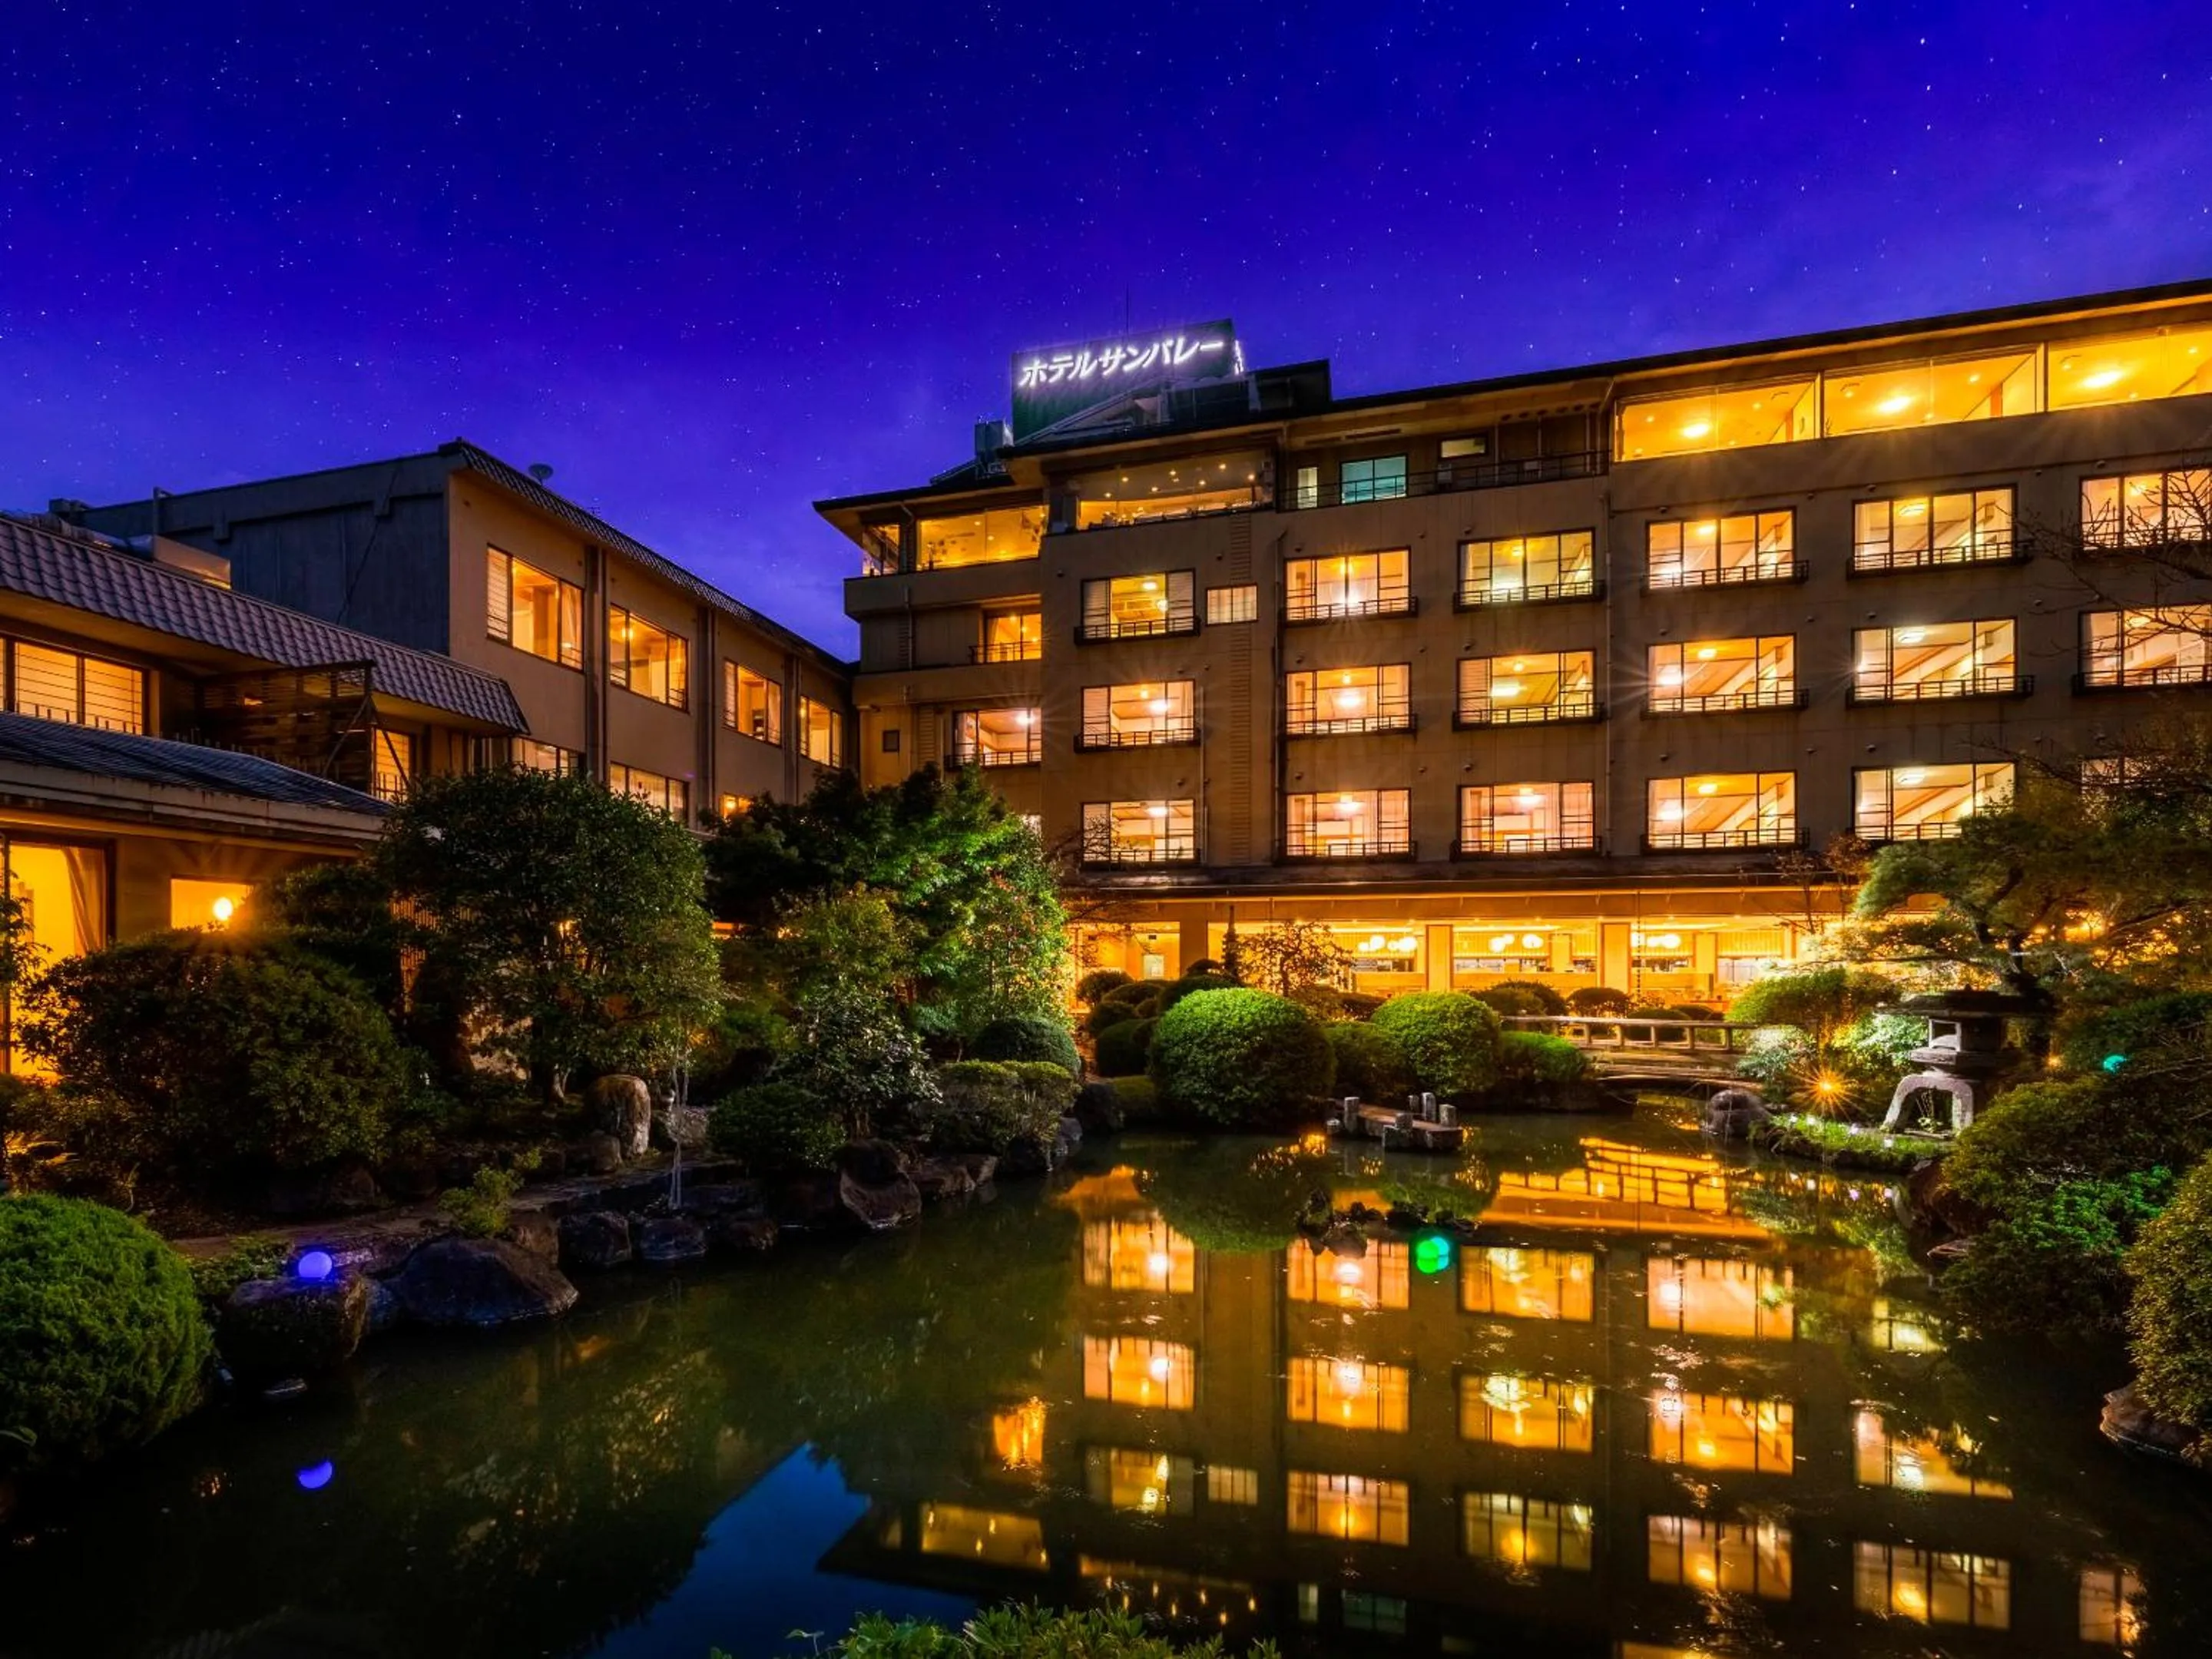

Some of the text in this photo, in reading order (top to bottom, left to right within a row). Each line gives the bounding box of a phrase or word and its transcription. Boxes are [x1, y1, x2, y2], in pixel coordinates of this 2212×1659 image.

[1018, 337, 1224, 388] ホテルサンバレー
